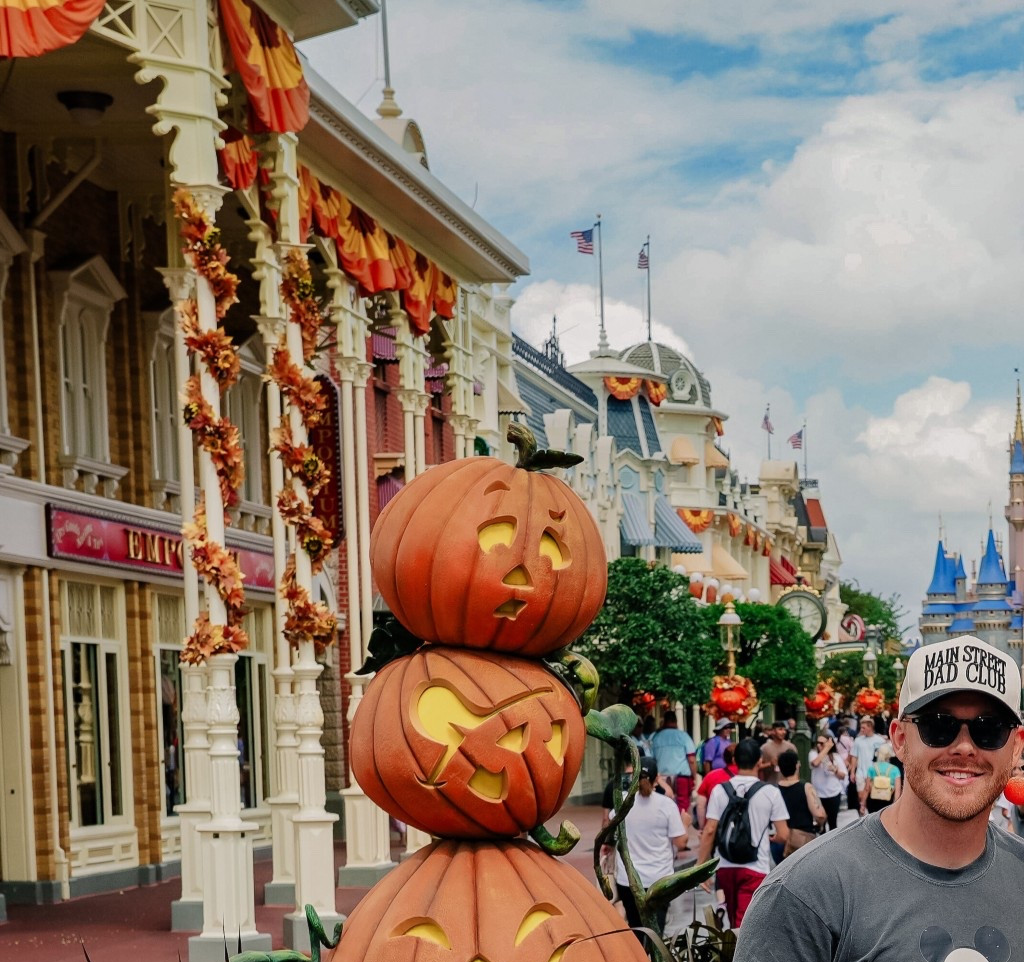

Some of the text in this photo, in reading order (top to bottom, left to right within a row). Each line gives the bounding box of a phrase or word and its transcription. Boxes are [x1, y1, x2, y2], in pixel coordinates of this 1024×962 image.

[925, 645, 1006, 676] MAIN STREET
[924, 662, 1006, 694] DAD CLUB
